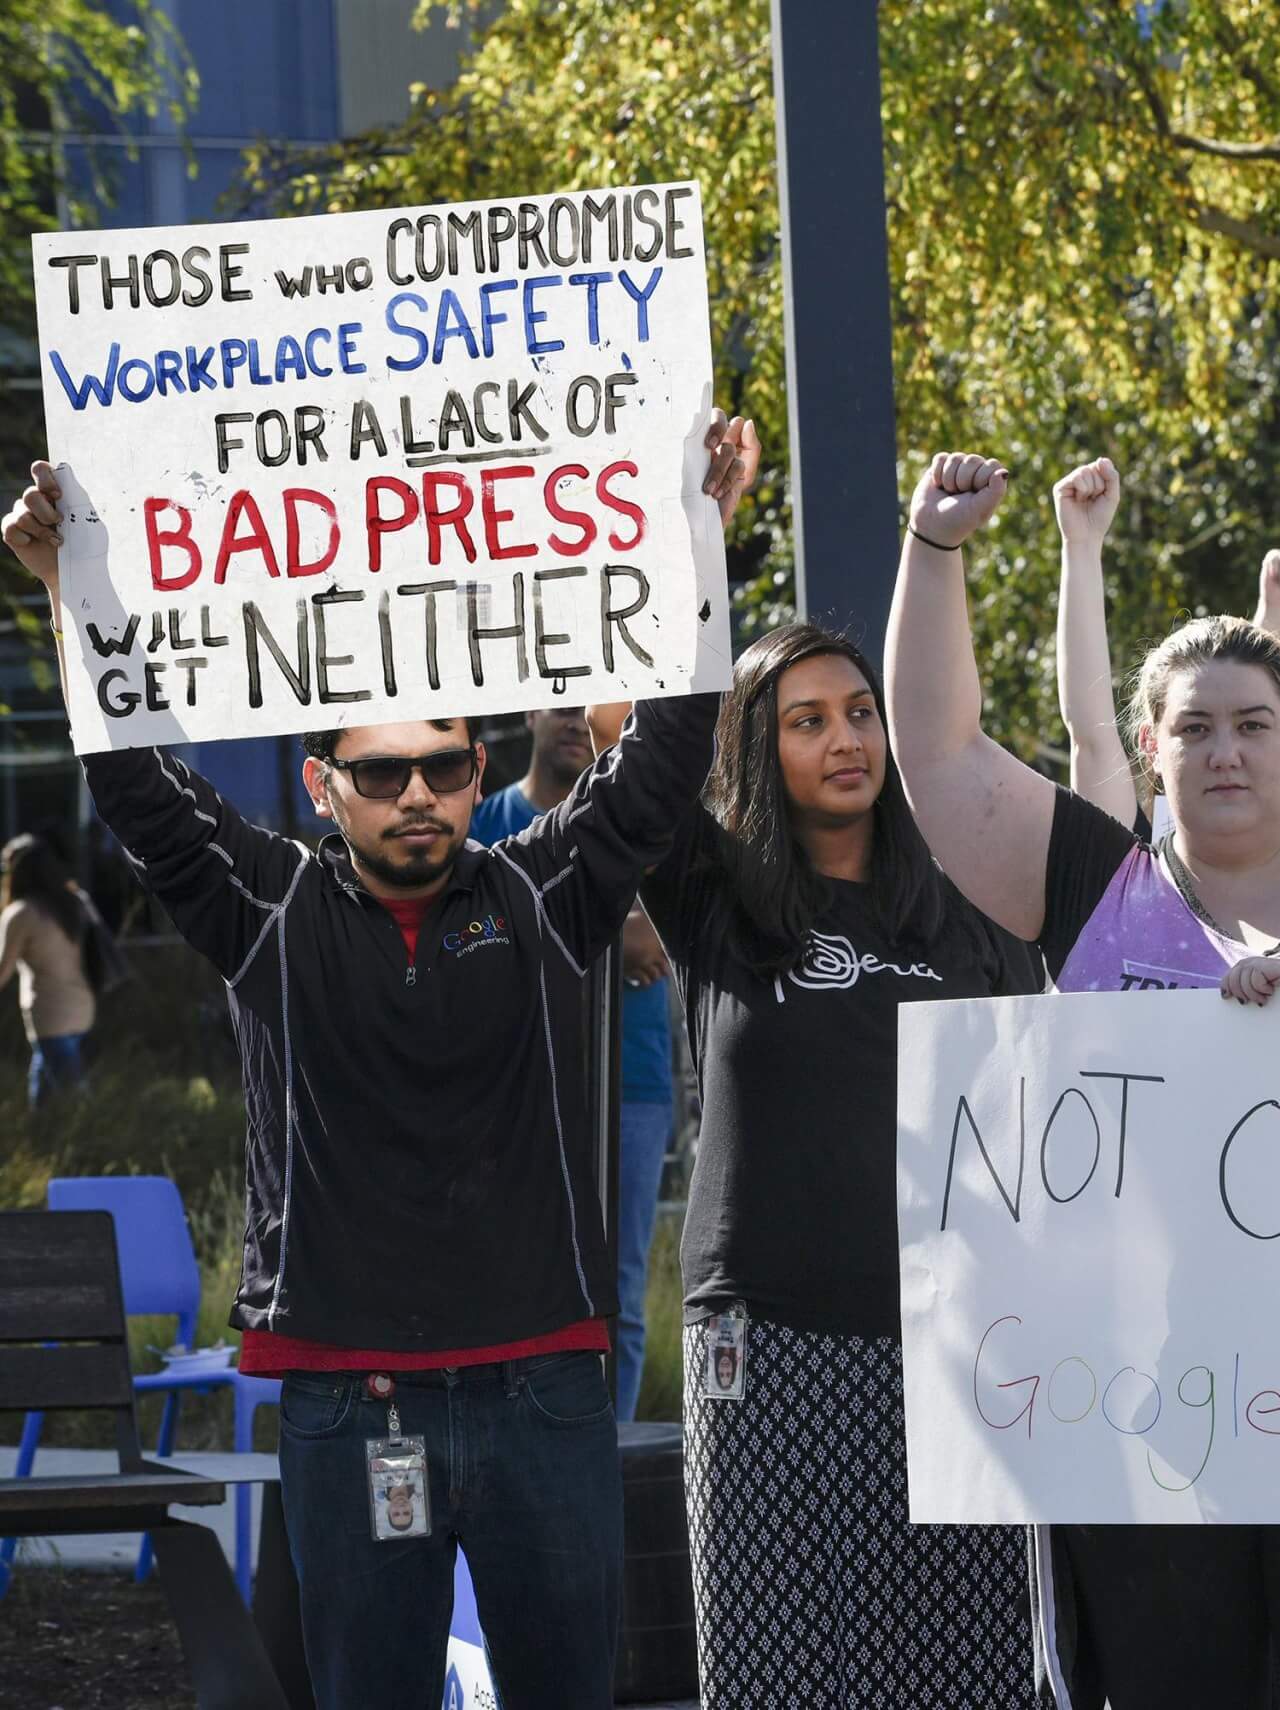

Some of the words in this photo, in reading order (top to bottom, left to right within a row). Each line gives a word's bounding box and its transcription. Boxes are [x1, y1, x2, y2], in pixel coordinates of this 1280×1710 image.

[47, 243, 254, 315] THOSE
[273, 256, 375, 300] WHO
[386, 187, 696, 287] COMPROMISE
[48, 321, 368, 411] WORKPLACE
[384, 266, 664, 373] SAFETY
[214, 404, 330, 474] FOR
[349, 399, 388, 461] A
[401, 378, 549, 454] LACK
[565, 372, 640, 439] OF
[144, 487, 342, 593] BAD
[364, 460, 650, 575] PRESS
[86, 603, 231, 659] WILL
[98, 656, 209, 719] GET
[242, 563, 656, 709] NEITHER
[443, 914, 507, 950] Google
[941, 1070, 1166, 1232] NOT
